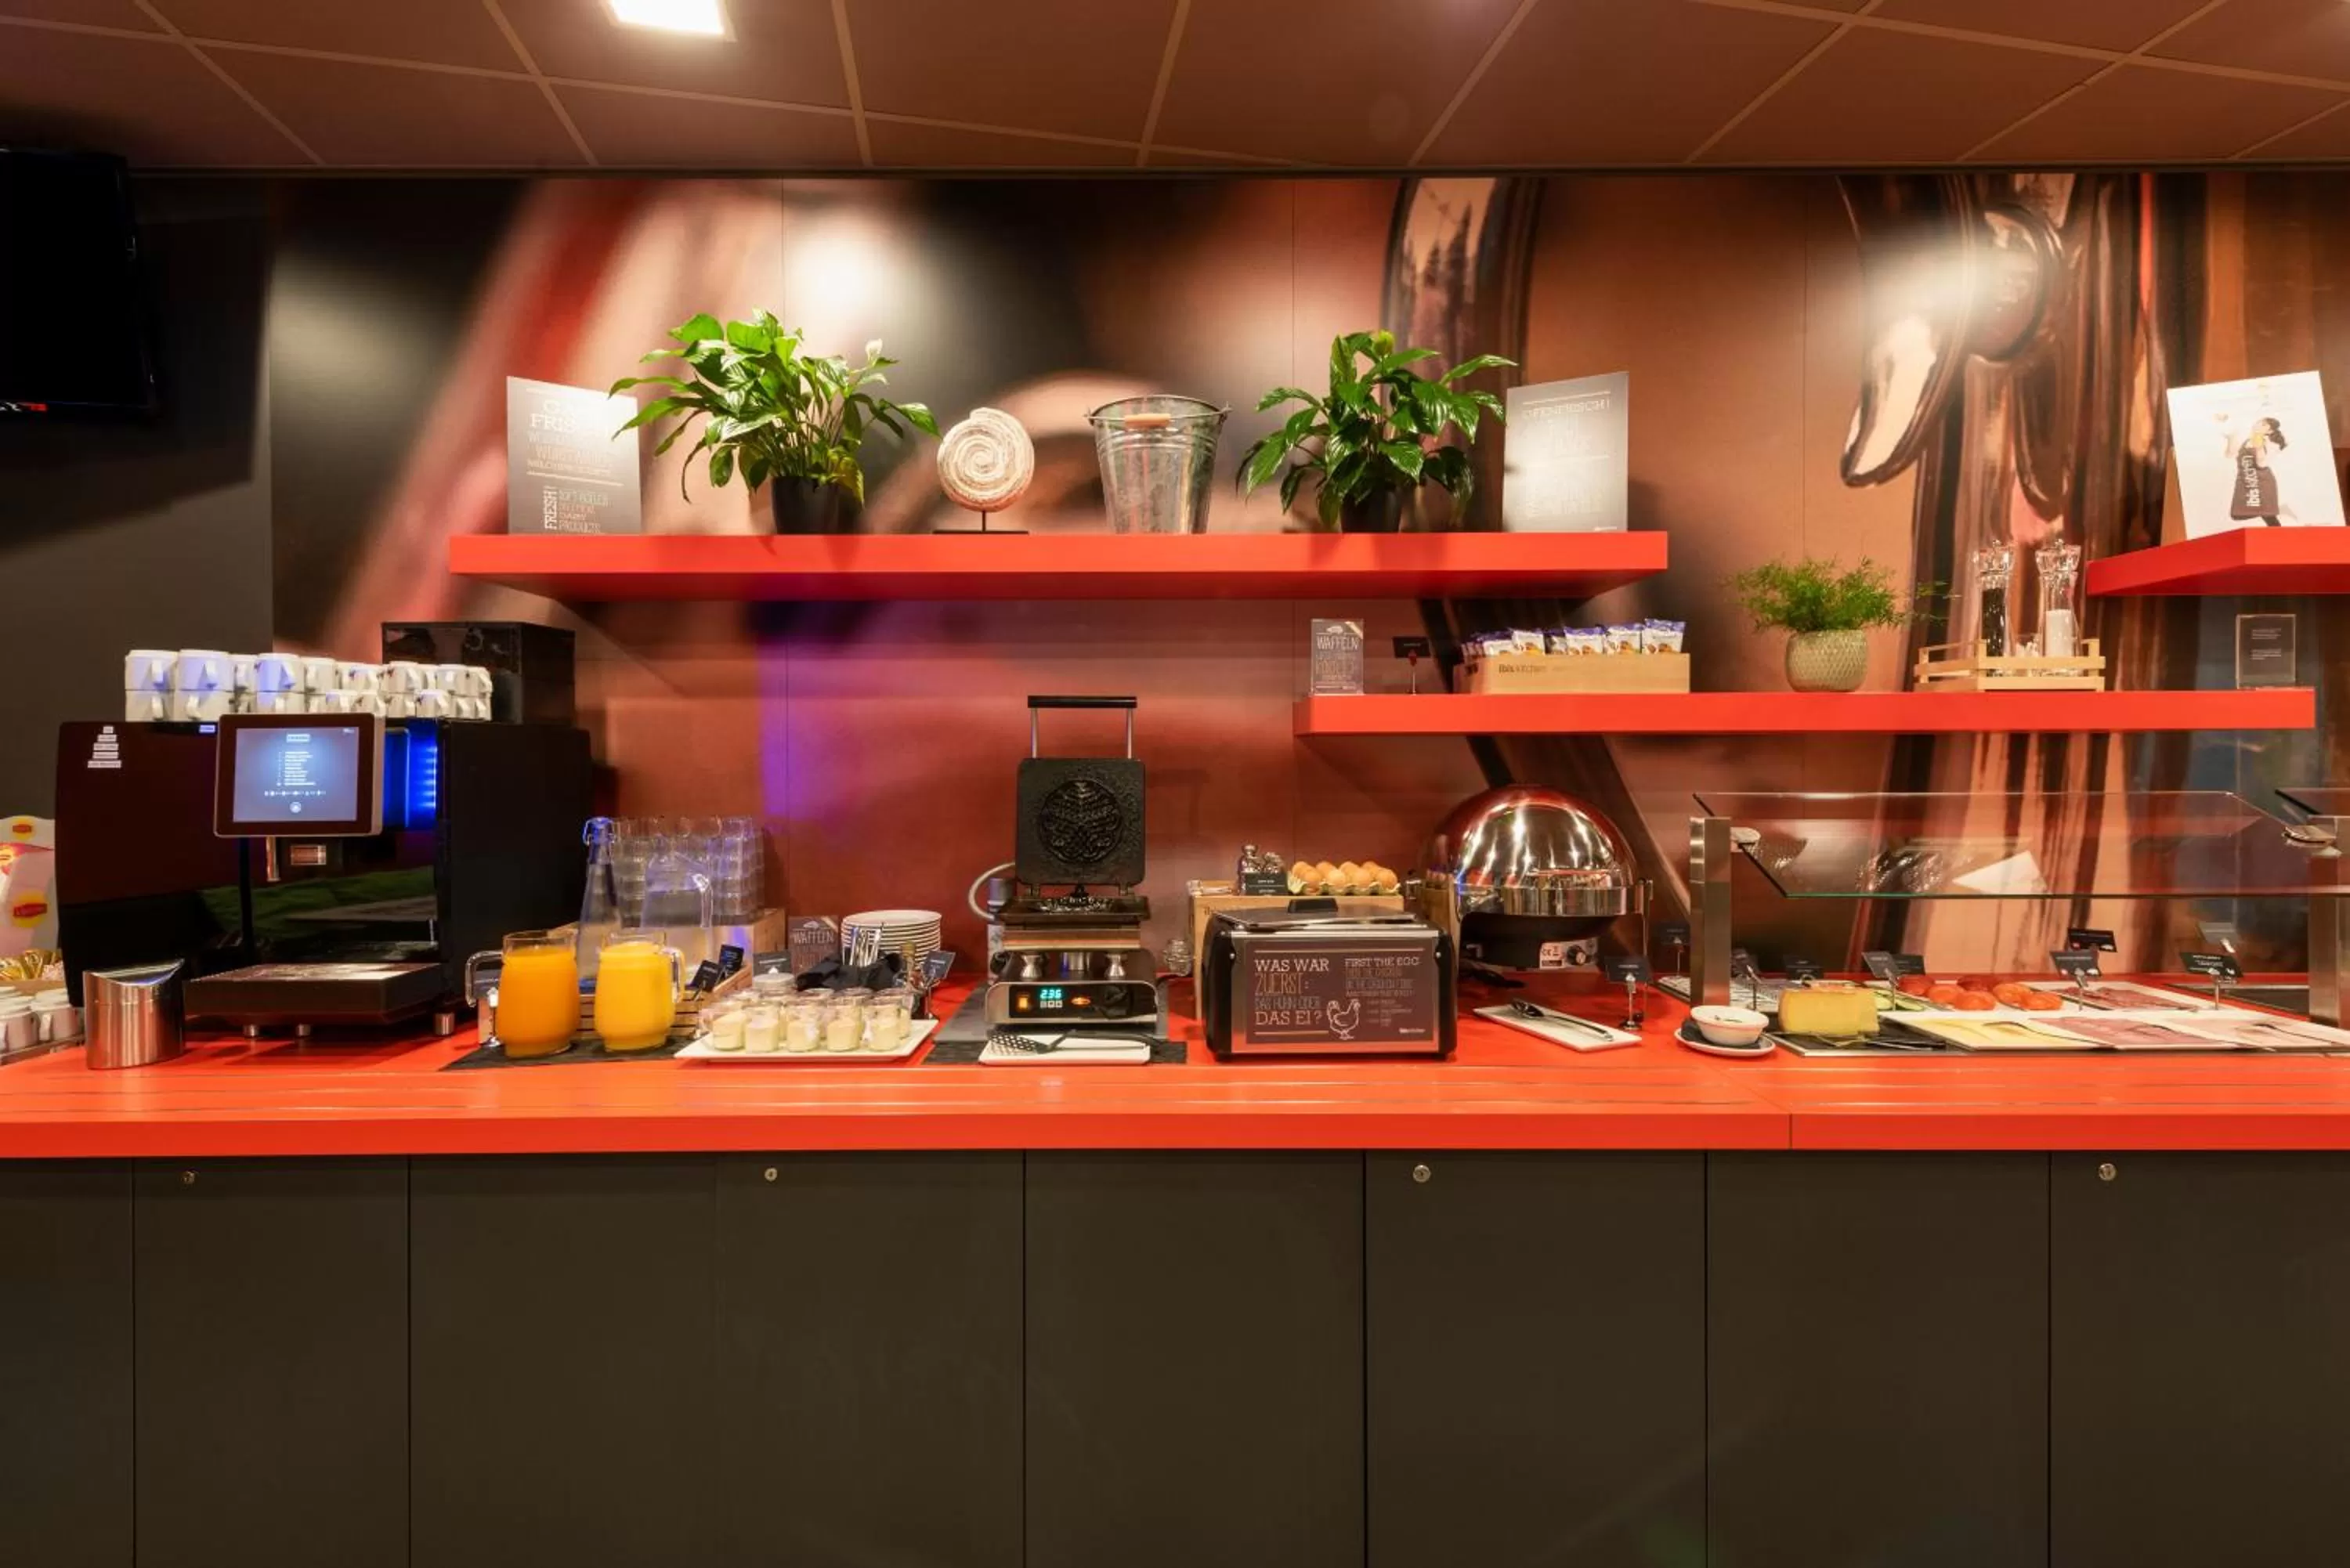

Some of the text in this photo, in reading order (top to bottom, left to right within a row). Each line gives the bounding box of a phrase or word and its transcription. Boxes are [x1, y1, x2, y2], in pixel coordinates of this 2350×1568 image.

[1255, 958, 1329, 972] WAS WAR
[1255, 1011, 1291, 1025] DAS
